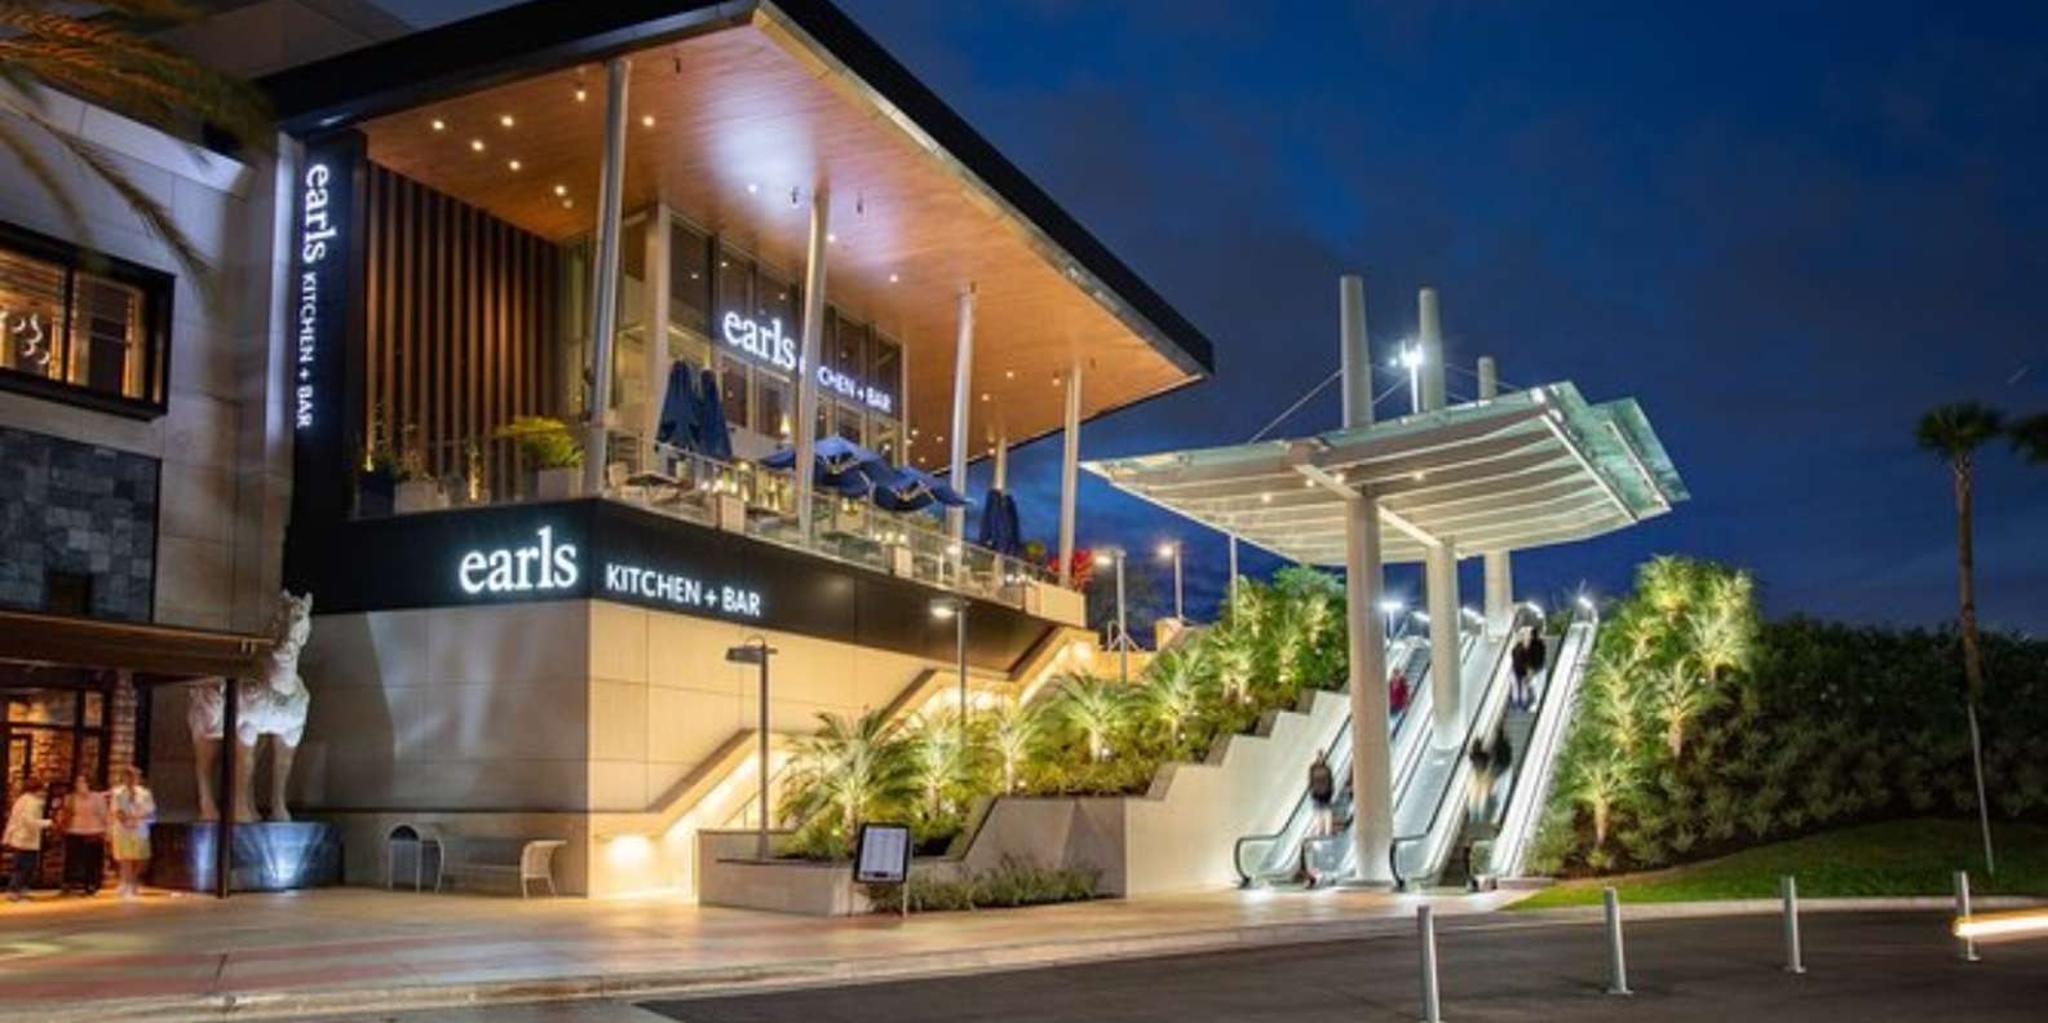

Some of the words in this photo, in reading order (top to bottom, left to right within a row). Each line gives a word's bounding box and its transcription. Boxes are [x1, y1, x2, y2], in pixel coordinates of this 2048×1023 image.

[304, 164, 338, 263] earls
[300, 272, 316, 362] KITCHEN
[723, 311, 797, 371] earls
[297, 385, 313, 429] BAR
[459, 525, 578, 594] earls
[605, 563, 701, 606] KITCHEN
[721, 586, 761, 616] BAR
